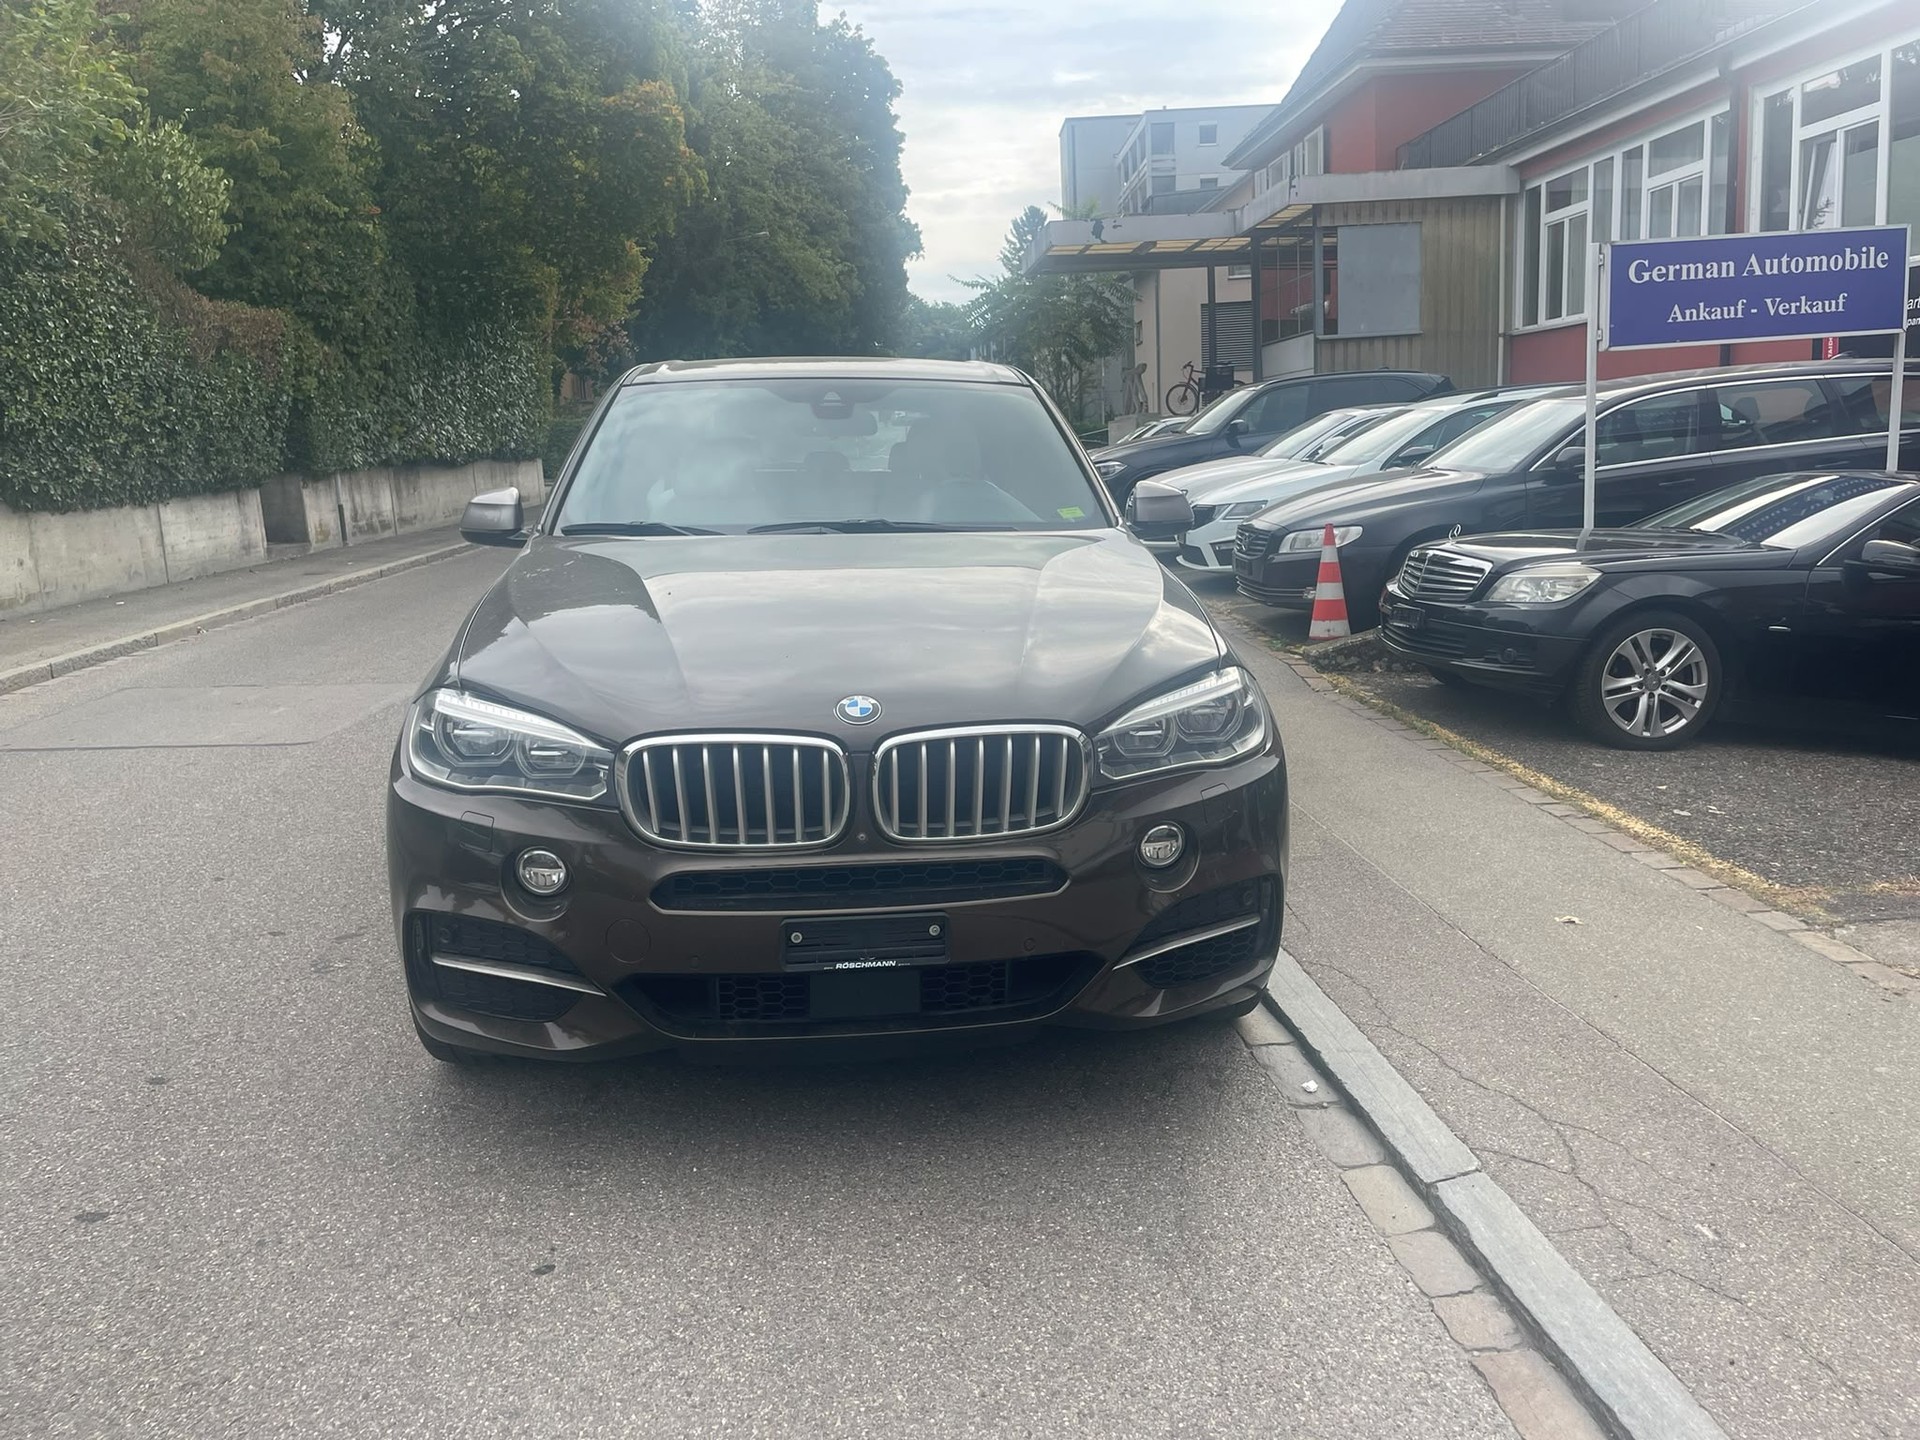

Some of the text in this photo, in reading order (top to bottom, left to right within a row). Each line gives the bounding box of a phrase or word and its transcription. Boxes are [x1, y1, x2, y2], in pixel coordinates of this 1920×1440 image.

[1628, 246, 1889, 284] German Automobile
[1667, 299, 1747, 323] Ankauf
[1764, 292, 1848, 317] Verkauf
[835, 960, 896, 969] RÖSCHMANN
